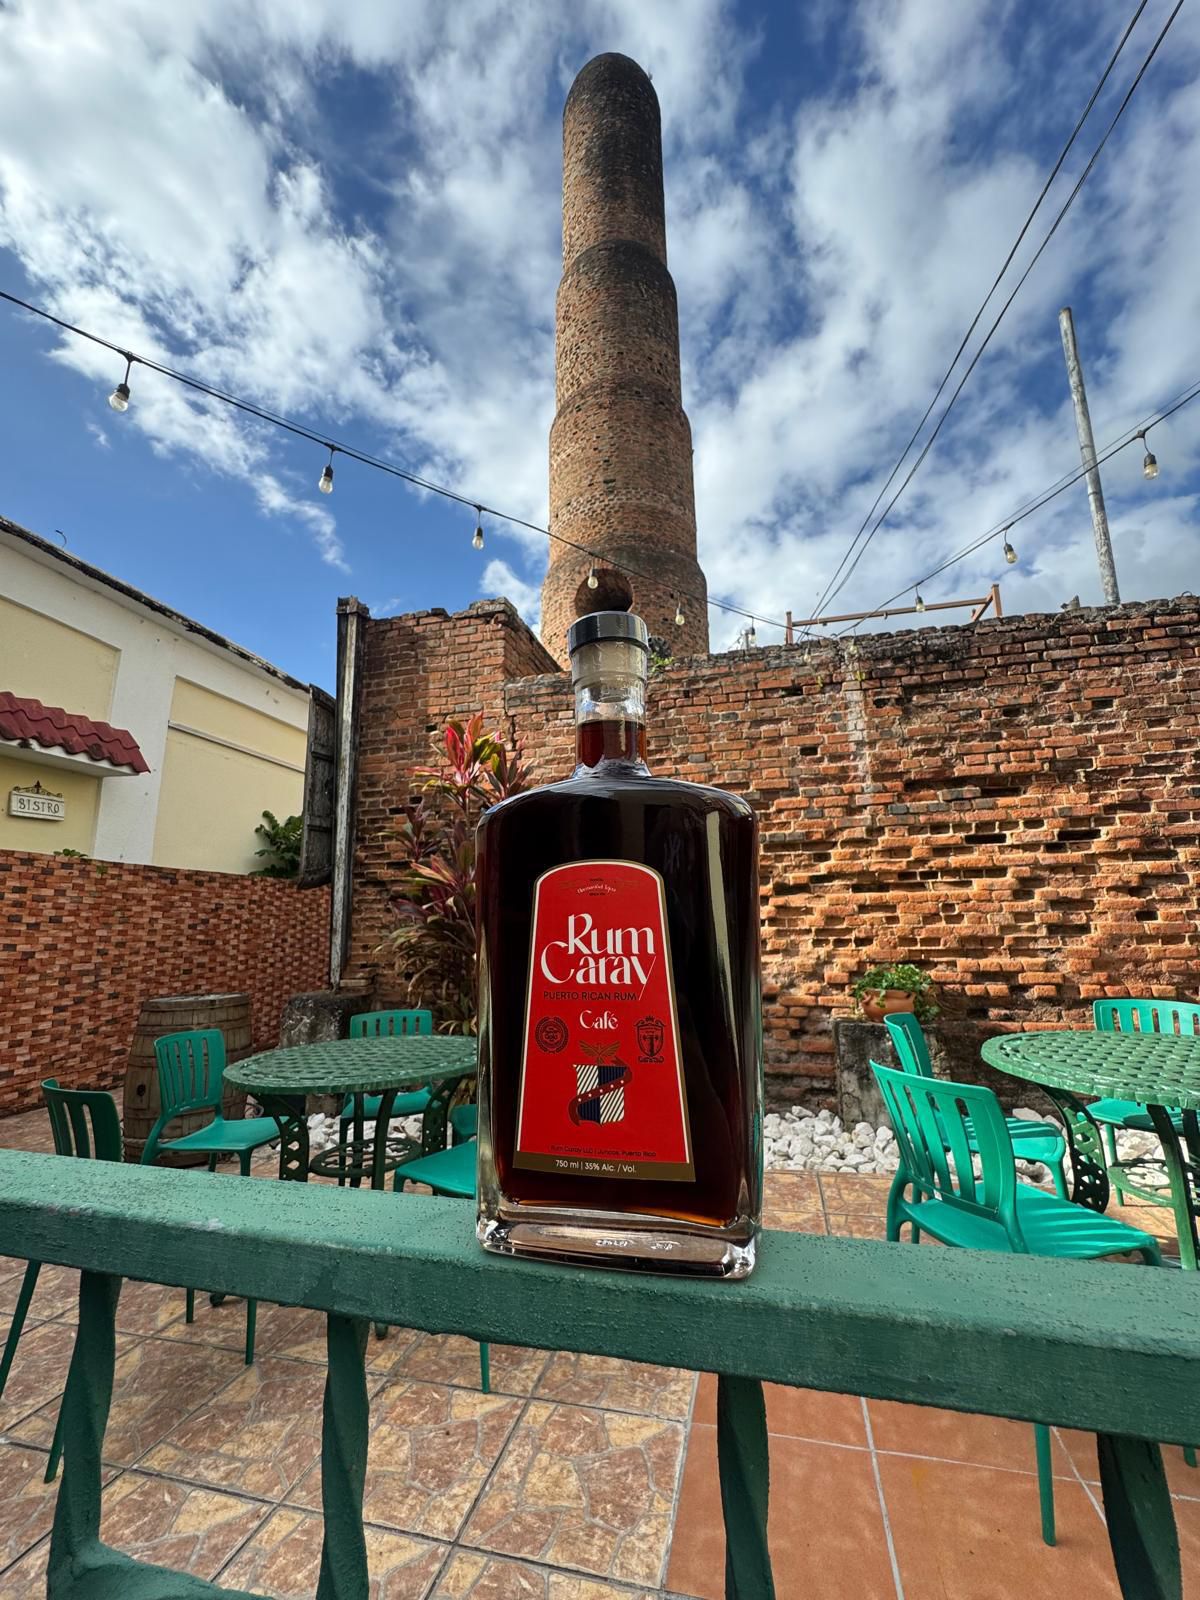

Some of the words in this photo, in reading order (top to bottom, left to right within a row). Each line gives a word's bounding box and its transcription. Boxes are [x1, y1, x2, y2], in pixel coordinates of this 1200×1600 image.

[18, 798, 60, 814] BISTRO
[567, 913, 655, 955] Rum
[541, 940, 657, 1001] Caray
[543, 990, 579, 1000] PUERTO
[581, 991, 611, 1001] RICAN
[614, 992, 637, 1001] RUM
[579, 1009, 619, 1030] Café
[555, 1159, 568, 1168] 750
[569, 1161, 579, 1169] ml
[584, 1162, 600, 1171] 35%
[622, 1164, 637, 1173] Vol.
